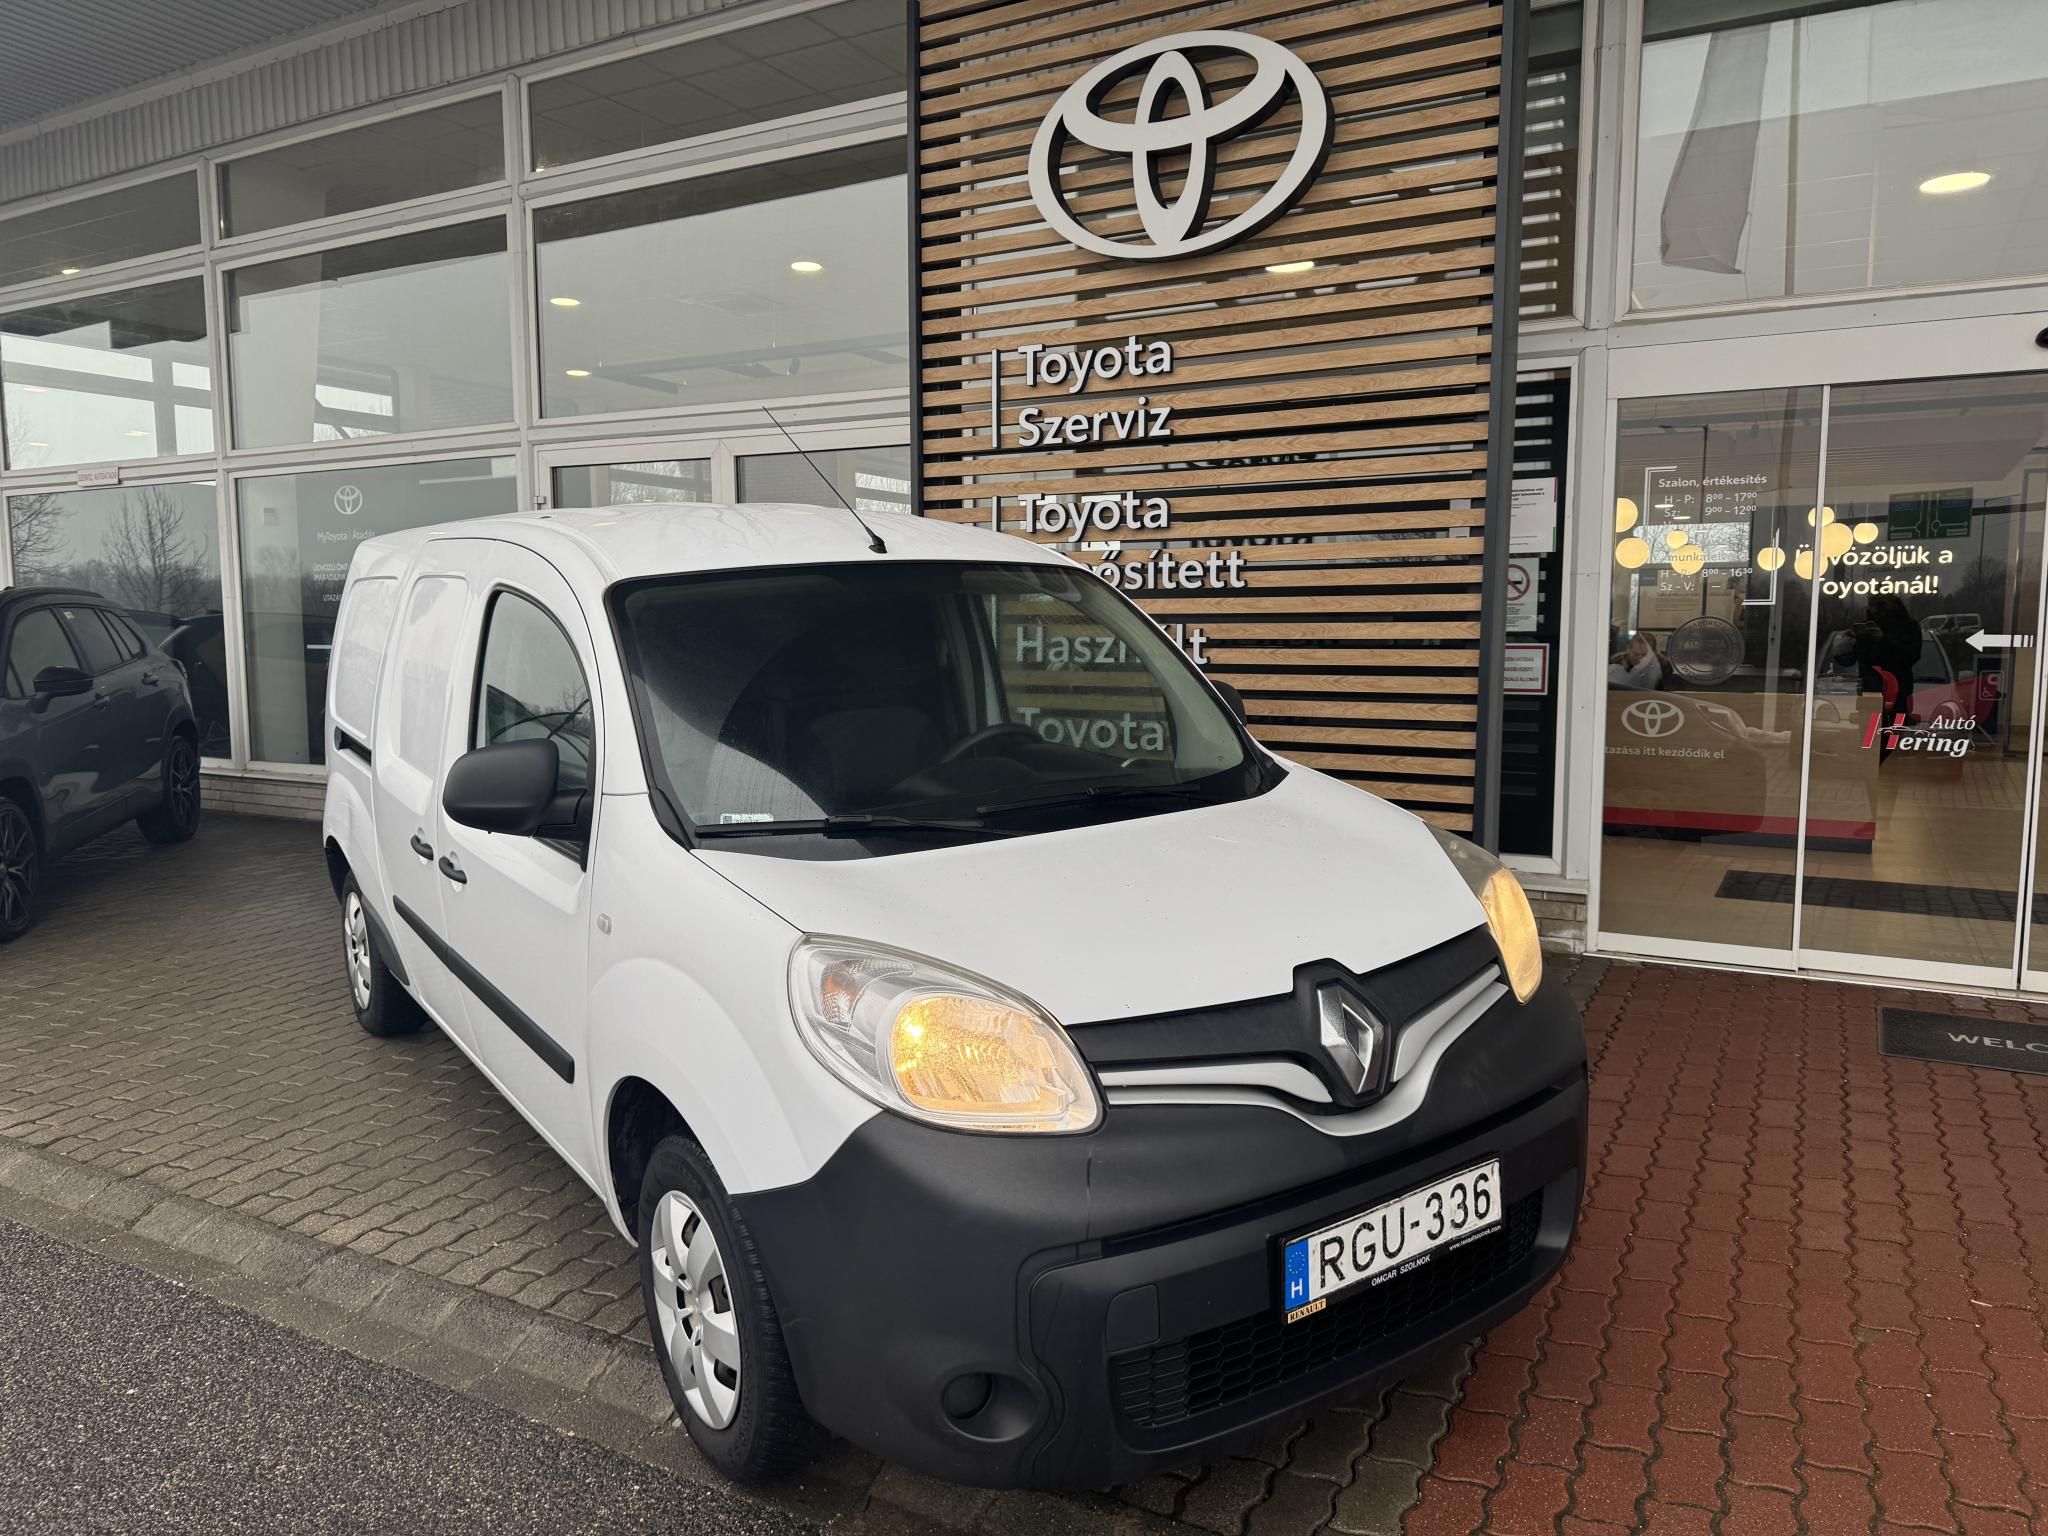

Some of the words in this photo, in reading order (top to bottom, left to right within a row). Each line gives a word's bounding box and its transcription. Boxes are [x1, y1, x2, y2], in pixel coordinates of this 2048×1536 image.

[1018, 336, 1173, 393] Toyota
[1017, 396, 1172, 448] Szerviz
[1658, 477, 1700, 488] Szalon,
[1703, 474, 1767, 486] értékesítés
[1684, 495, 1695, 504] P:
[1017, 490, 1170, 543] Toyota
[1088, 549, 1247, 590] ősített
[1796, 544, 1929, 569] vözöljük
[1938, 549, 1953, 564] a
[1818, 575, 1939, 599] oyotánál!
[1016, 623, 1208, 665] Hasznlt
[1861, 713, 1970, 758] Hering
[1929, 715, 1977, 730] Autó
[1604, 746, 1640, 756] tazása
[1643, 746, 1657, 756] itt
[1658, 747, 1711, 759] kezdődik
[1713, 748, 1725, 759] el
[1319, 1172, 1492, 1289] RGU-336
[1371, 1268, 1397, 1287] OMCAR
[1399, 1253, 1431, 1275] SZOLNOK
[1290, 1278, 1303, 1299] H
[1288, 1300, 1326, 1322] RENAULT
